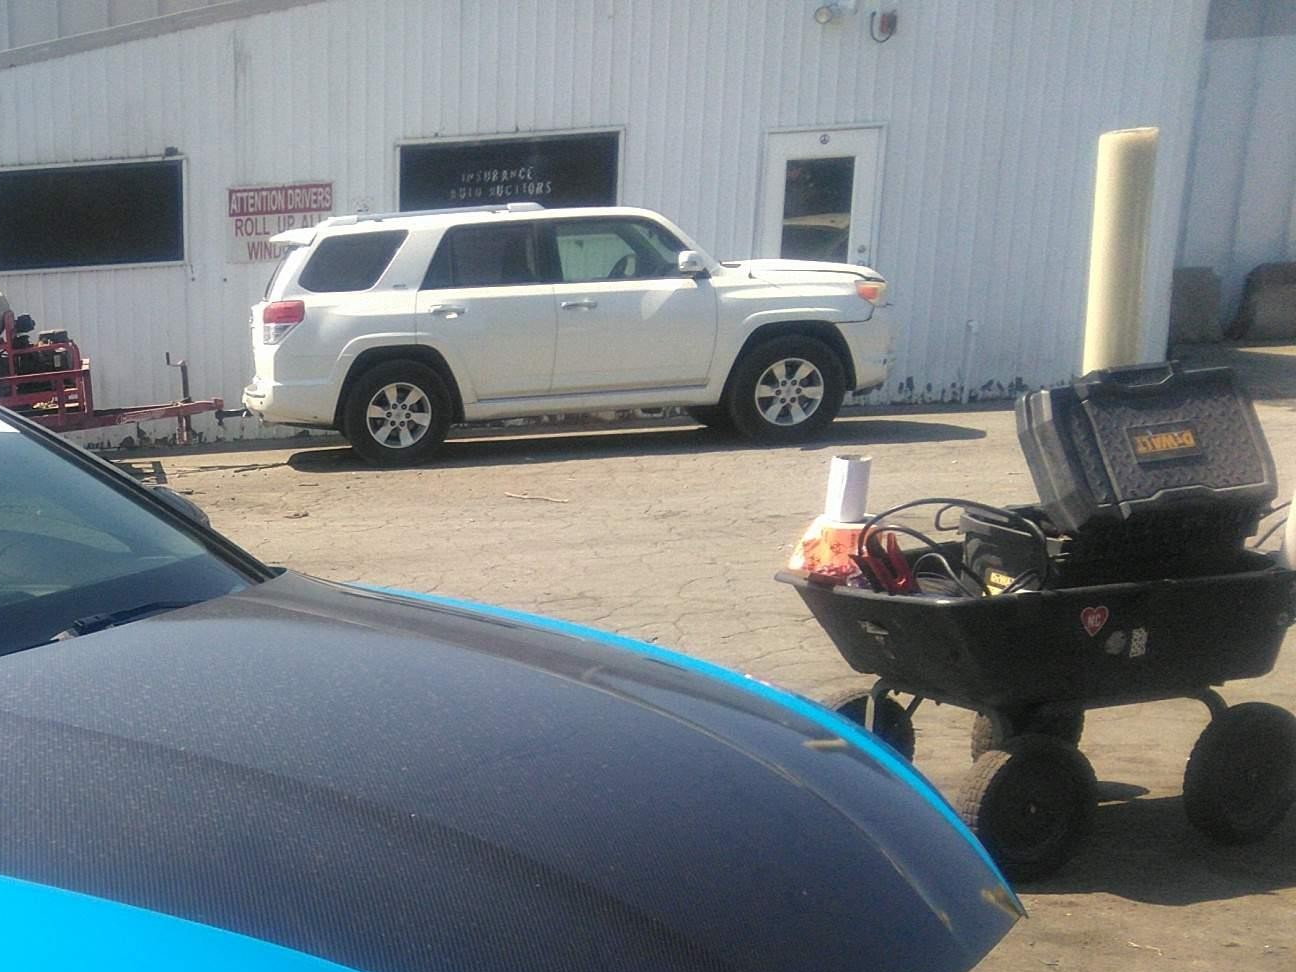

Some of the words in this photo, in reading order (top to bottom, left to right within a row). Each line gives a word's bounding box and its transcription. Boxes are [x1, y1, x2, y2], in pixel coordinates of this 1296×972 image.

[461, 166, 534, 184] INSURANCE
[230, 189, 286, 214] ATTENTION
[287, 187, 331, 210] DRIVERS
[234, 217, 270, 237] ROLL
[277, 216, 295, 232] UP
